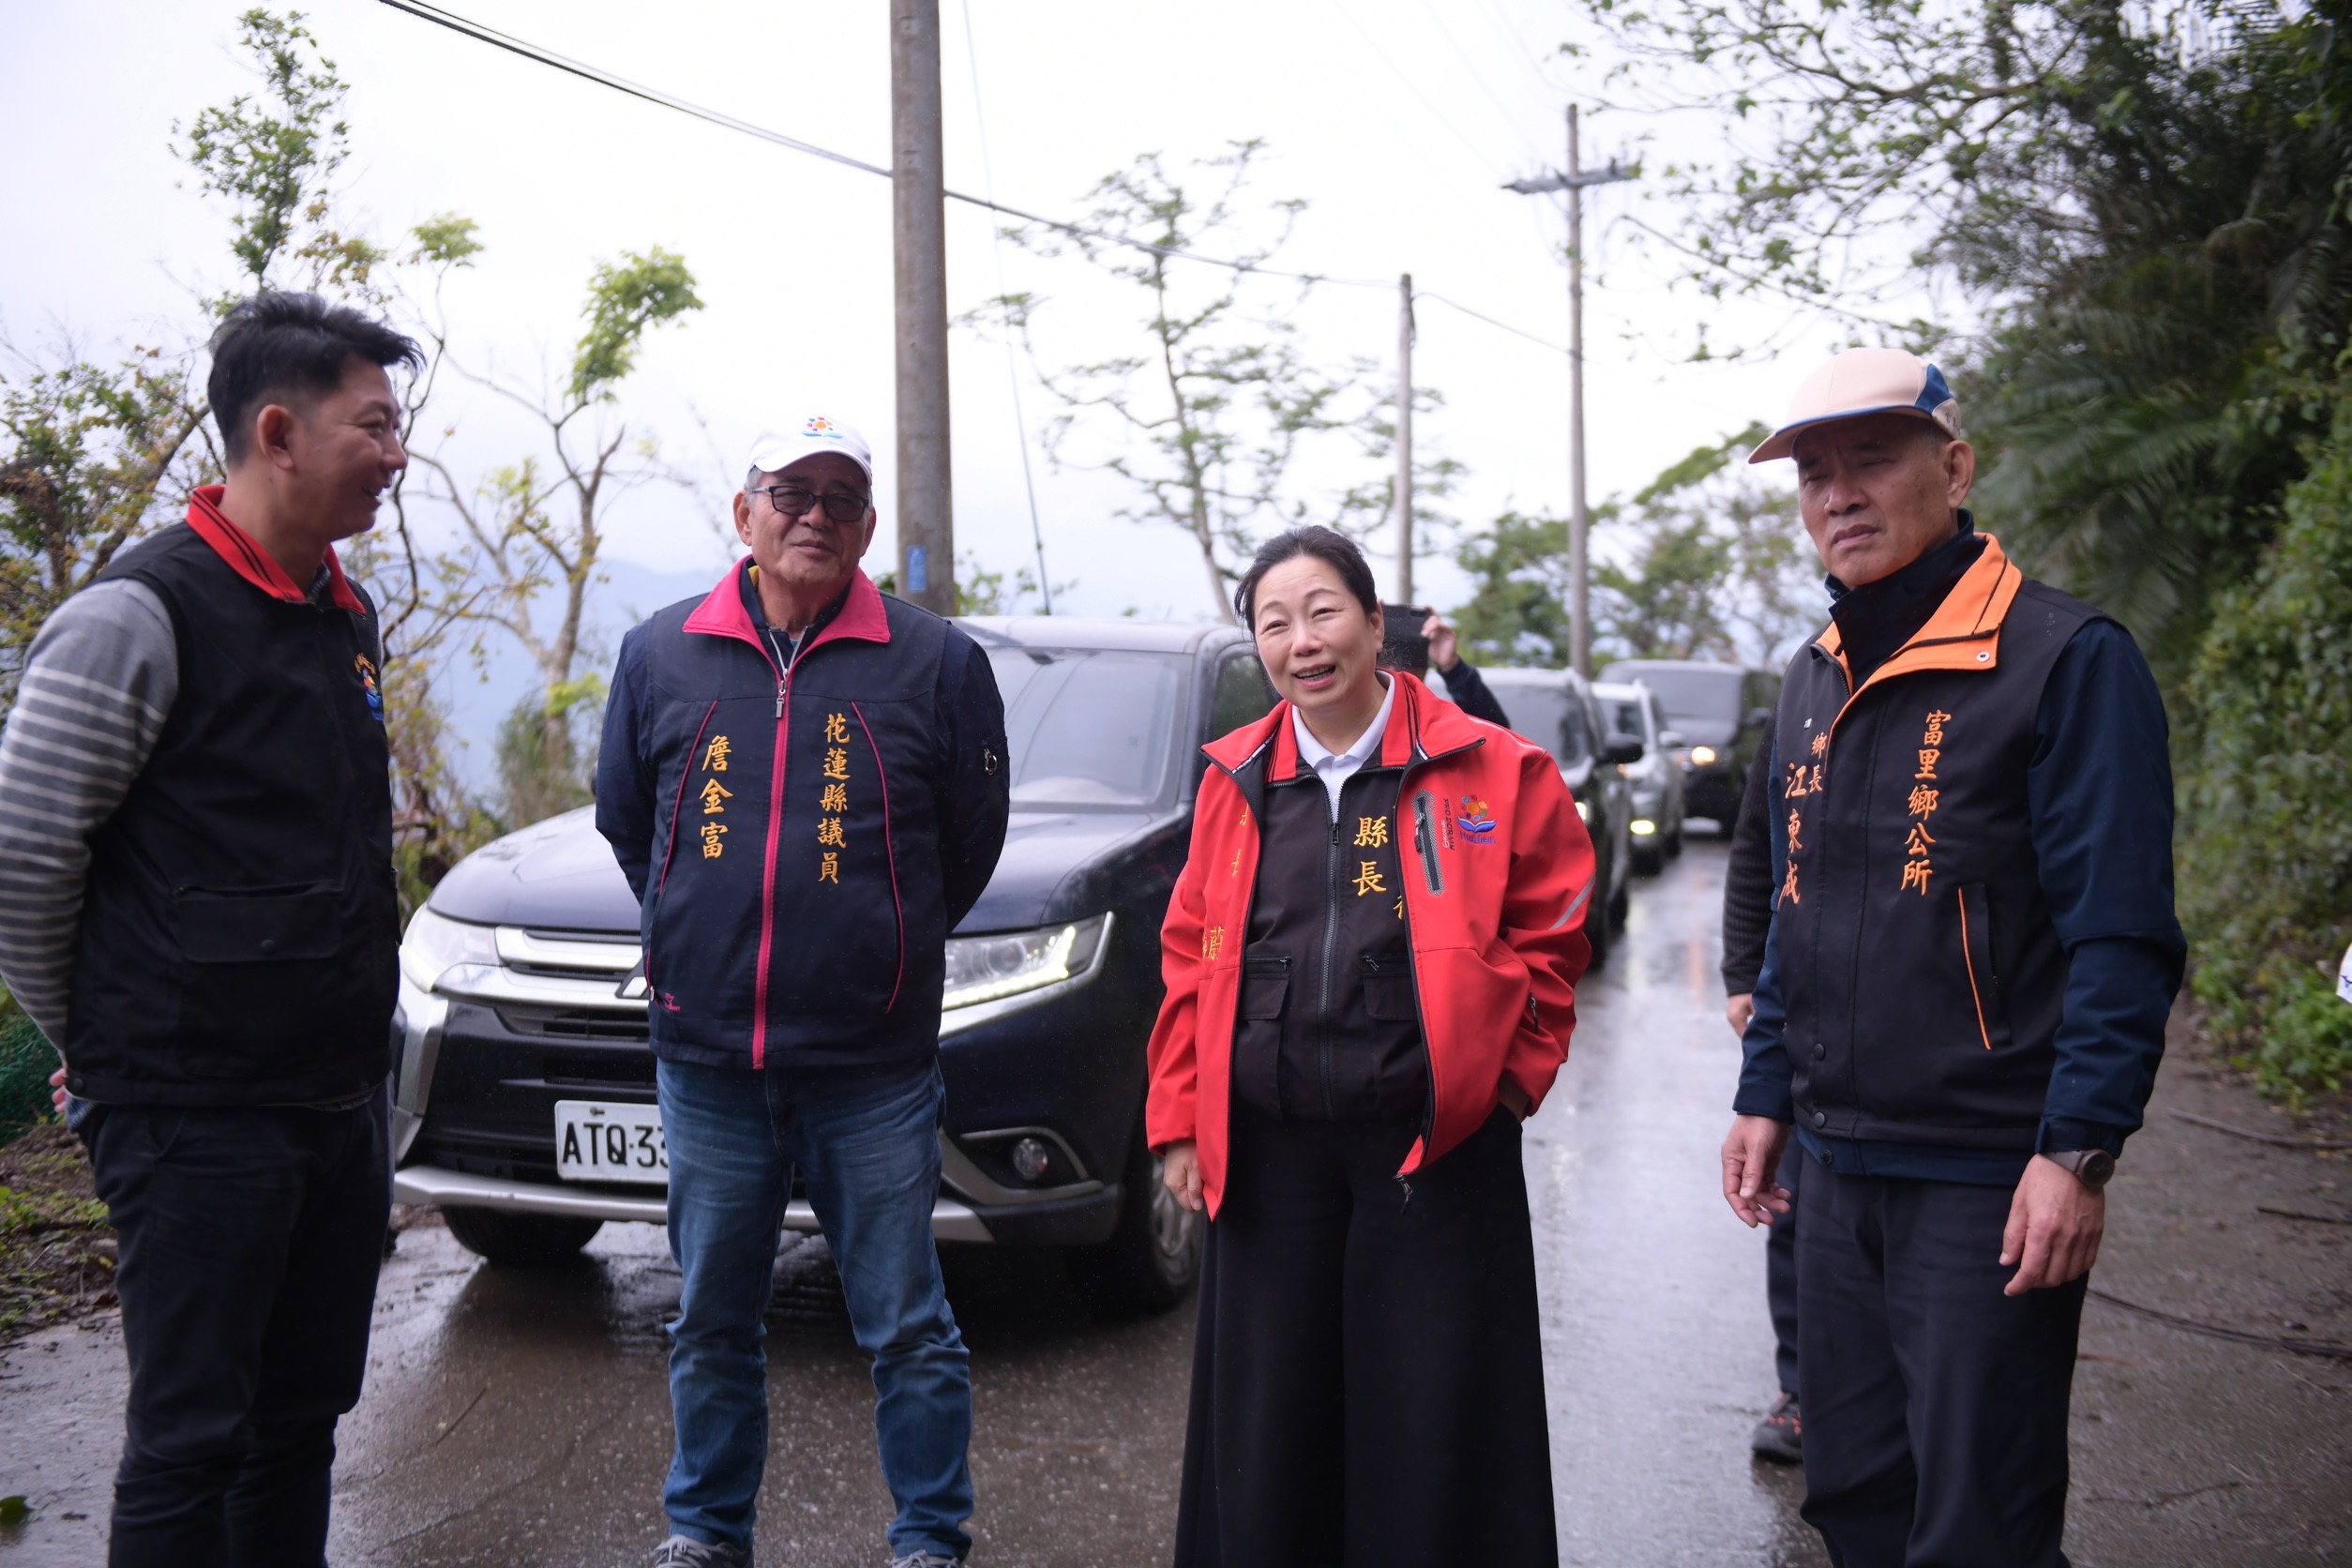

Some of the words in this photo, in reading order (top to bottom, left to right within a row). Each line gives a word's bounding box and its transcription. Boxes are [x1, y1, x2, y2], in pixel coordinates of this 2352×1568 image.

[701, 734, 733, 860] 詹金富
[817, 713, 851, 884] 花蓮縣議員
[1809, 731, 1827, 794] 鄉長
[1900, 709, 1952, 897] 富里鄉公所
[1352, 815, 1389, 897] 縣長
